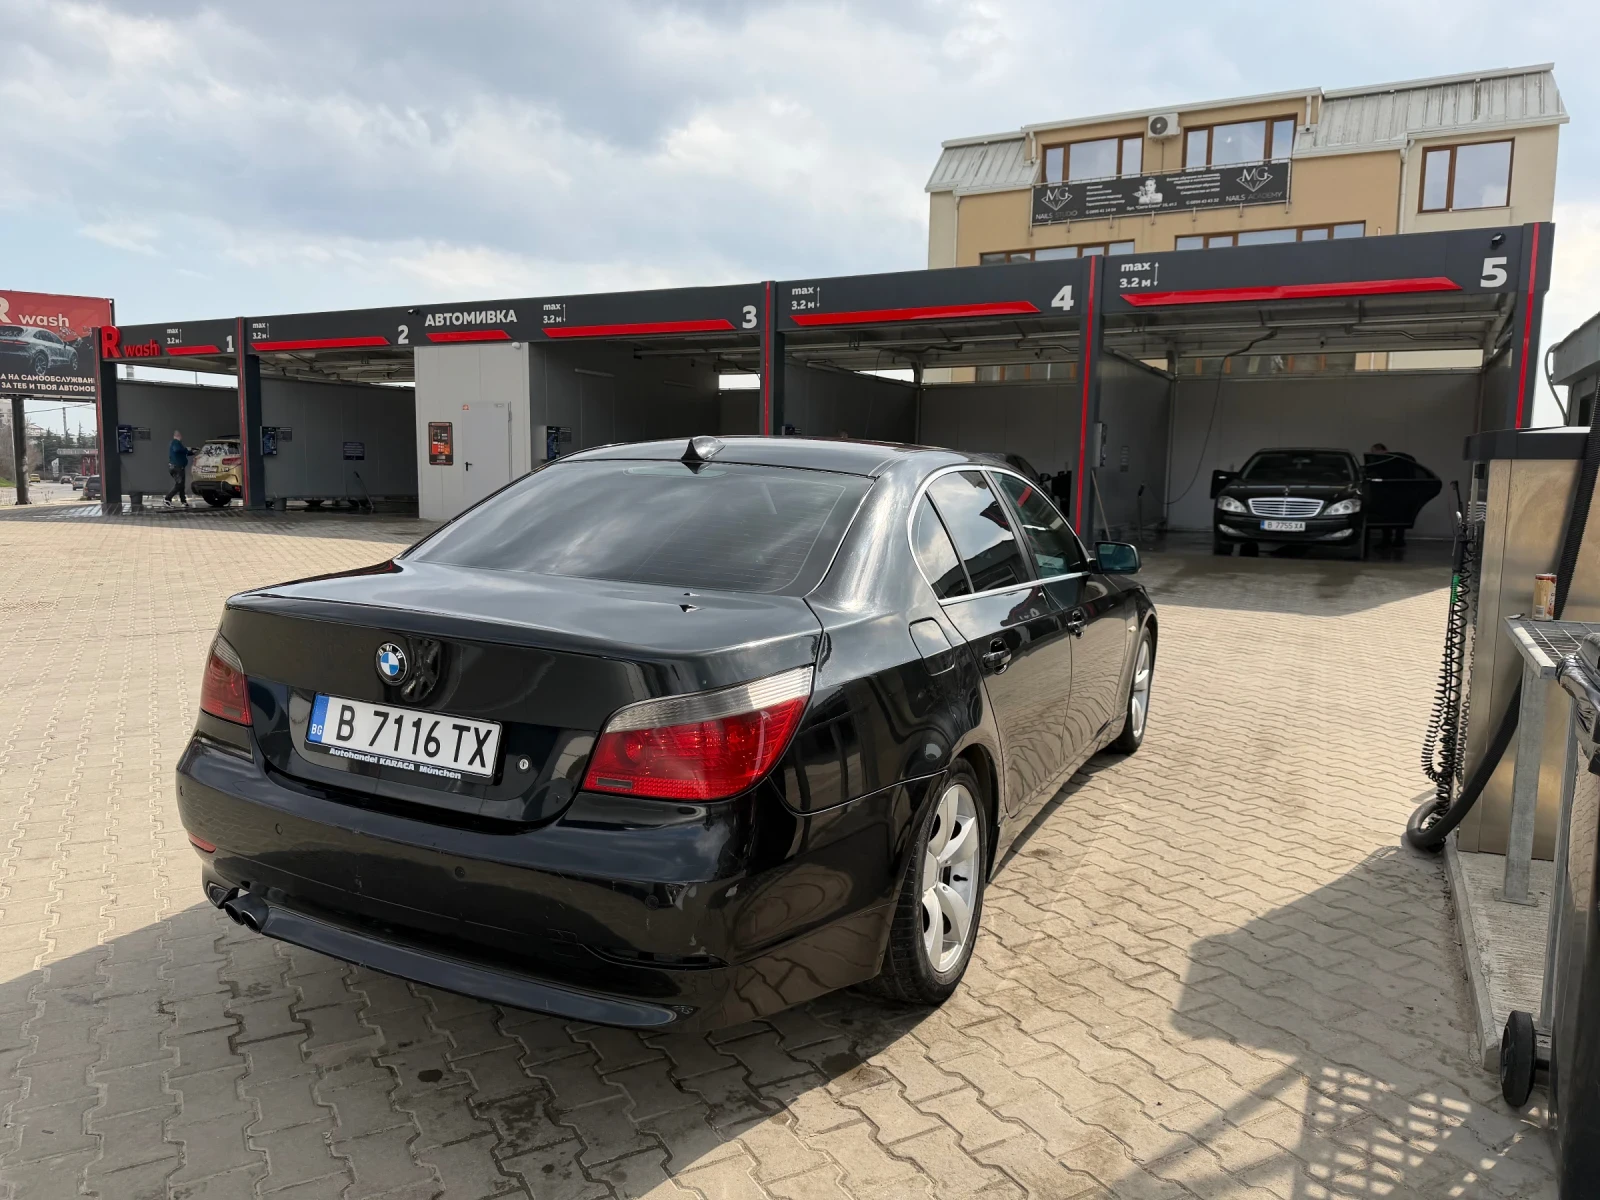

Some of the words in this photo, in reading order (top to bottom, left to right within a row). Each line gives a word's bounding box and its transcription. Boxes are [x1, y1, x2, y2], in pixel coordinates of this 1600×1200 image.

[1241, 166, 1268, 182] MG
[1045, 187, 1069, 201] MG
[1225, 194, 1246, 202] NAILS
[1035, 212, 1053, 220] NAILS
[1120, 261, 1151, 272] max
[1480, 256, 1508, 288] 5
[1119, 277, 1140, 288] 3.2
[791, 286, 814, 295] max
[1051, 285, 1075, 311] 4
[543, 303, 561, 311] max
[791, 300, 806, 310] 3.2
[18, 314, 70, 327] wash
[424, 309, 518, 327] АВТОМИВКА
[542, 315, 555, 324] 3.2
[742, 305, 758, 329] 3
[397, 325, 409, 345] 2
[100, 326, 123, 359] R
[123, 339, 160, 357] wash
[226, 335, 235, 353] 1
[8, 373, 20, 381] НА
[1, 381, 12, 389] ЗА
[37, 383, 57, 391] ТВОЯ
[378, 644, 404, 660] BMW
[310, 723, 323, 735] BG
[335, 704, 355, 742] B
[368, 710, 441, 758] 7116
[452, 723, 492, 768] TX
[329, 747, 378, 764] Autohandel
[379, 756, 415, 771] KARACA
[419, 765, 462, 780] München
